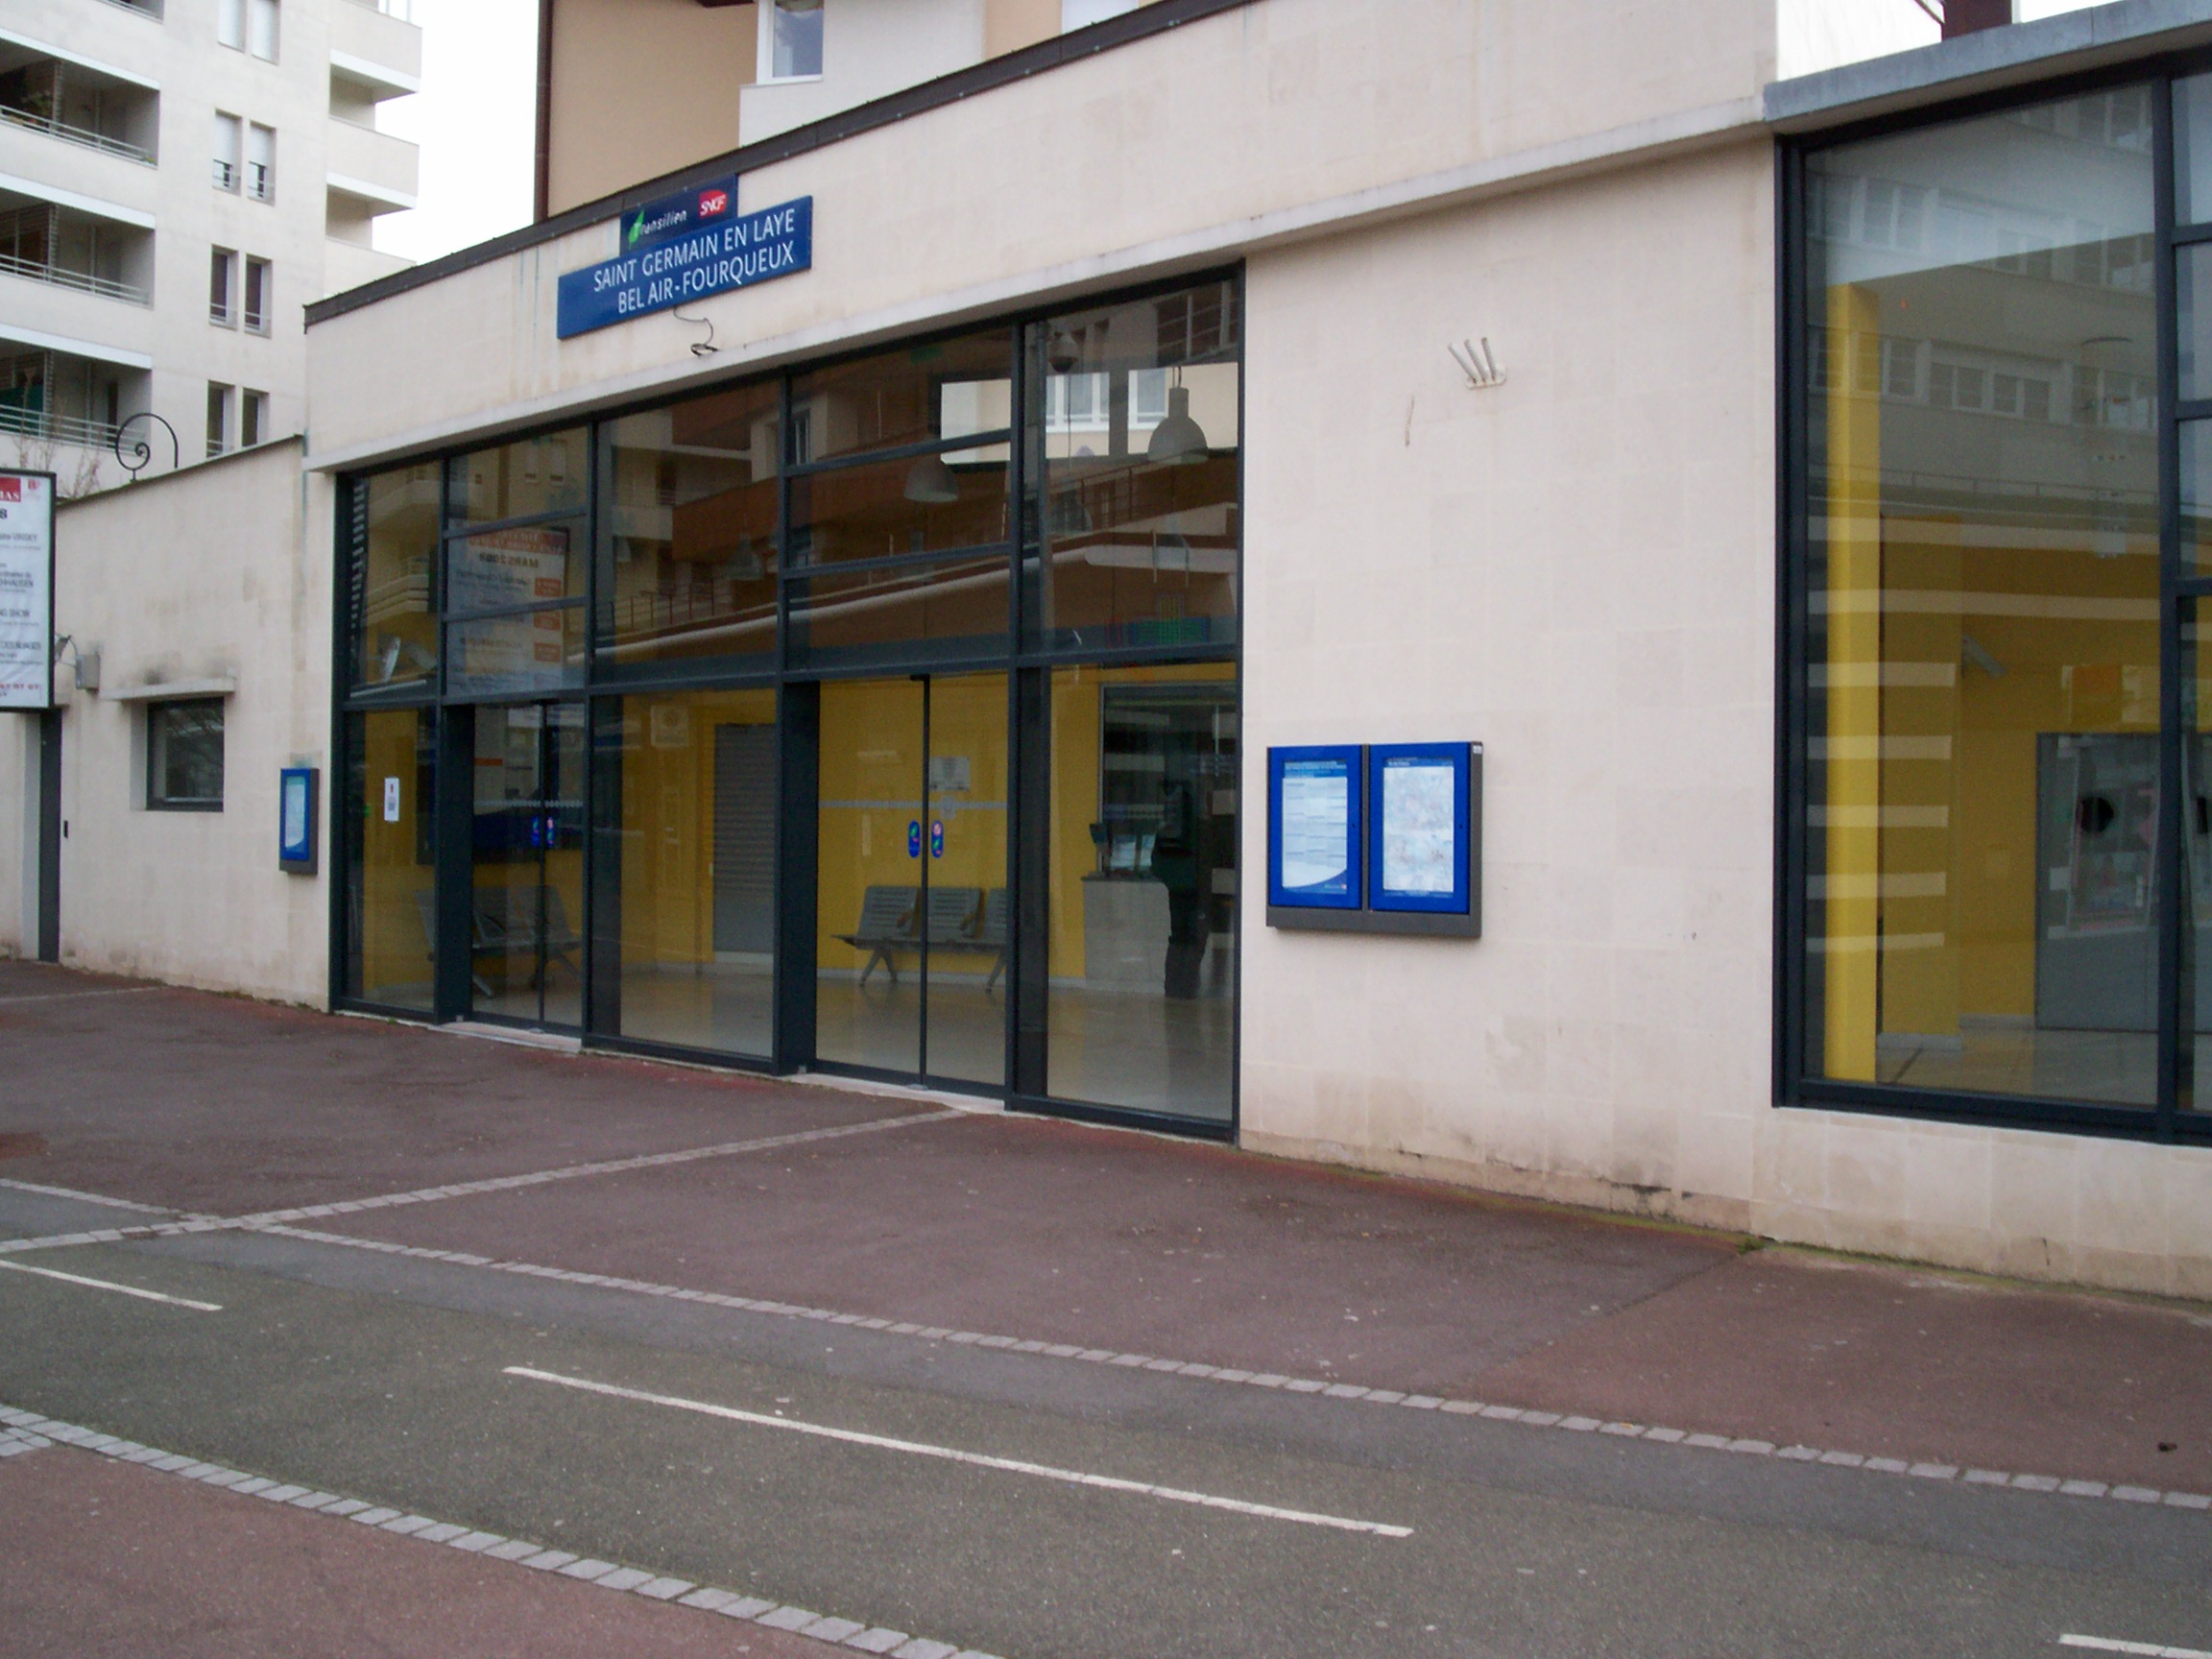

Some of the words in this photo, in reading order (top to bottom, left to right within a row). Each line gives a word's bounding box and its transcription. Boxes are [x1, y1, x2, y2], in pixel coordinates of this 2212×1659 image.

[699, 194, 727, 216] SNCF
[593, 258, 637, 292] SAINT
[641, 232, 718, 276] GERMAIN
[725, 223, 747, 252] EN
[754, 207, 796, 242] LAYE
[617, 286, 645, 314] BEL
